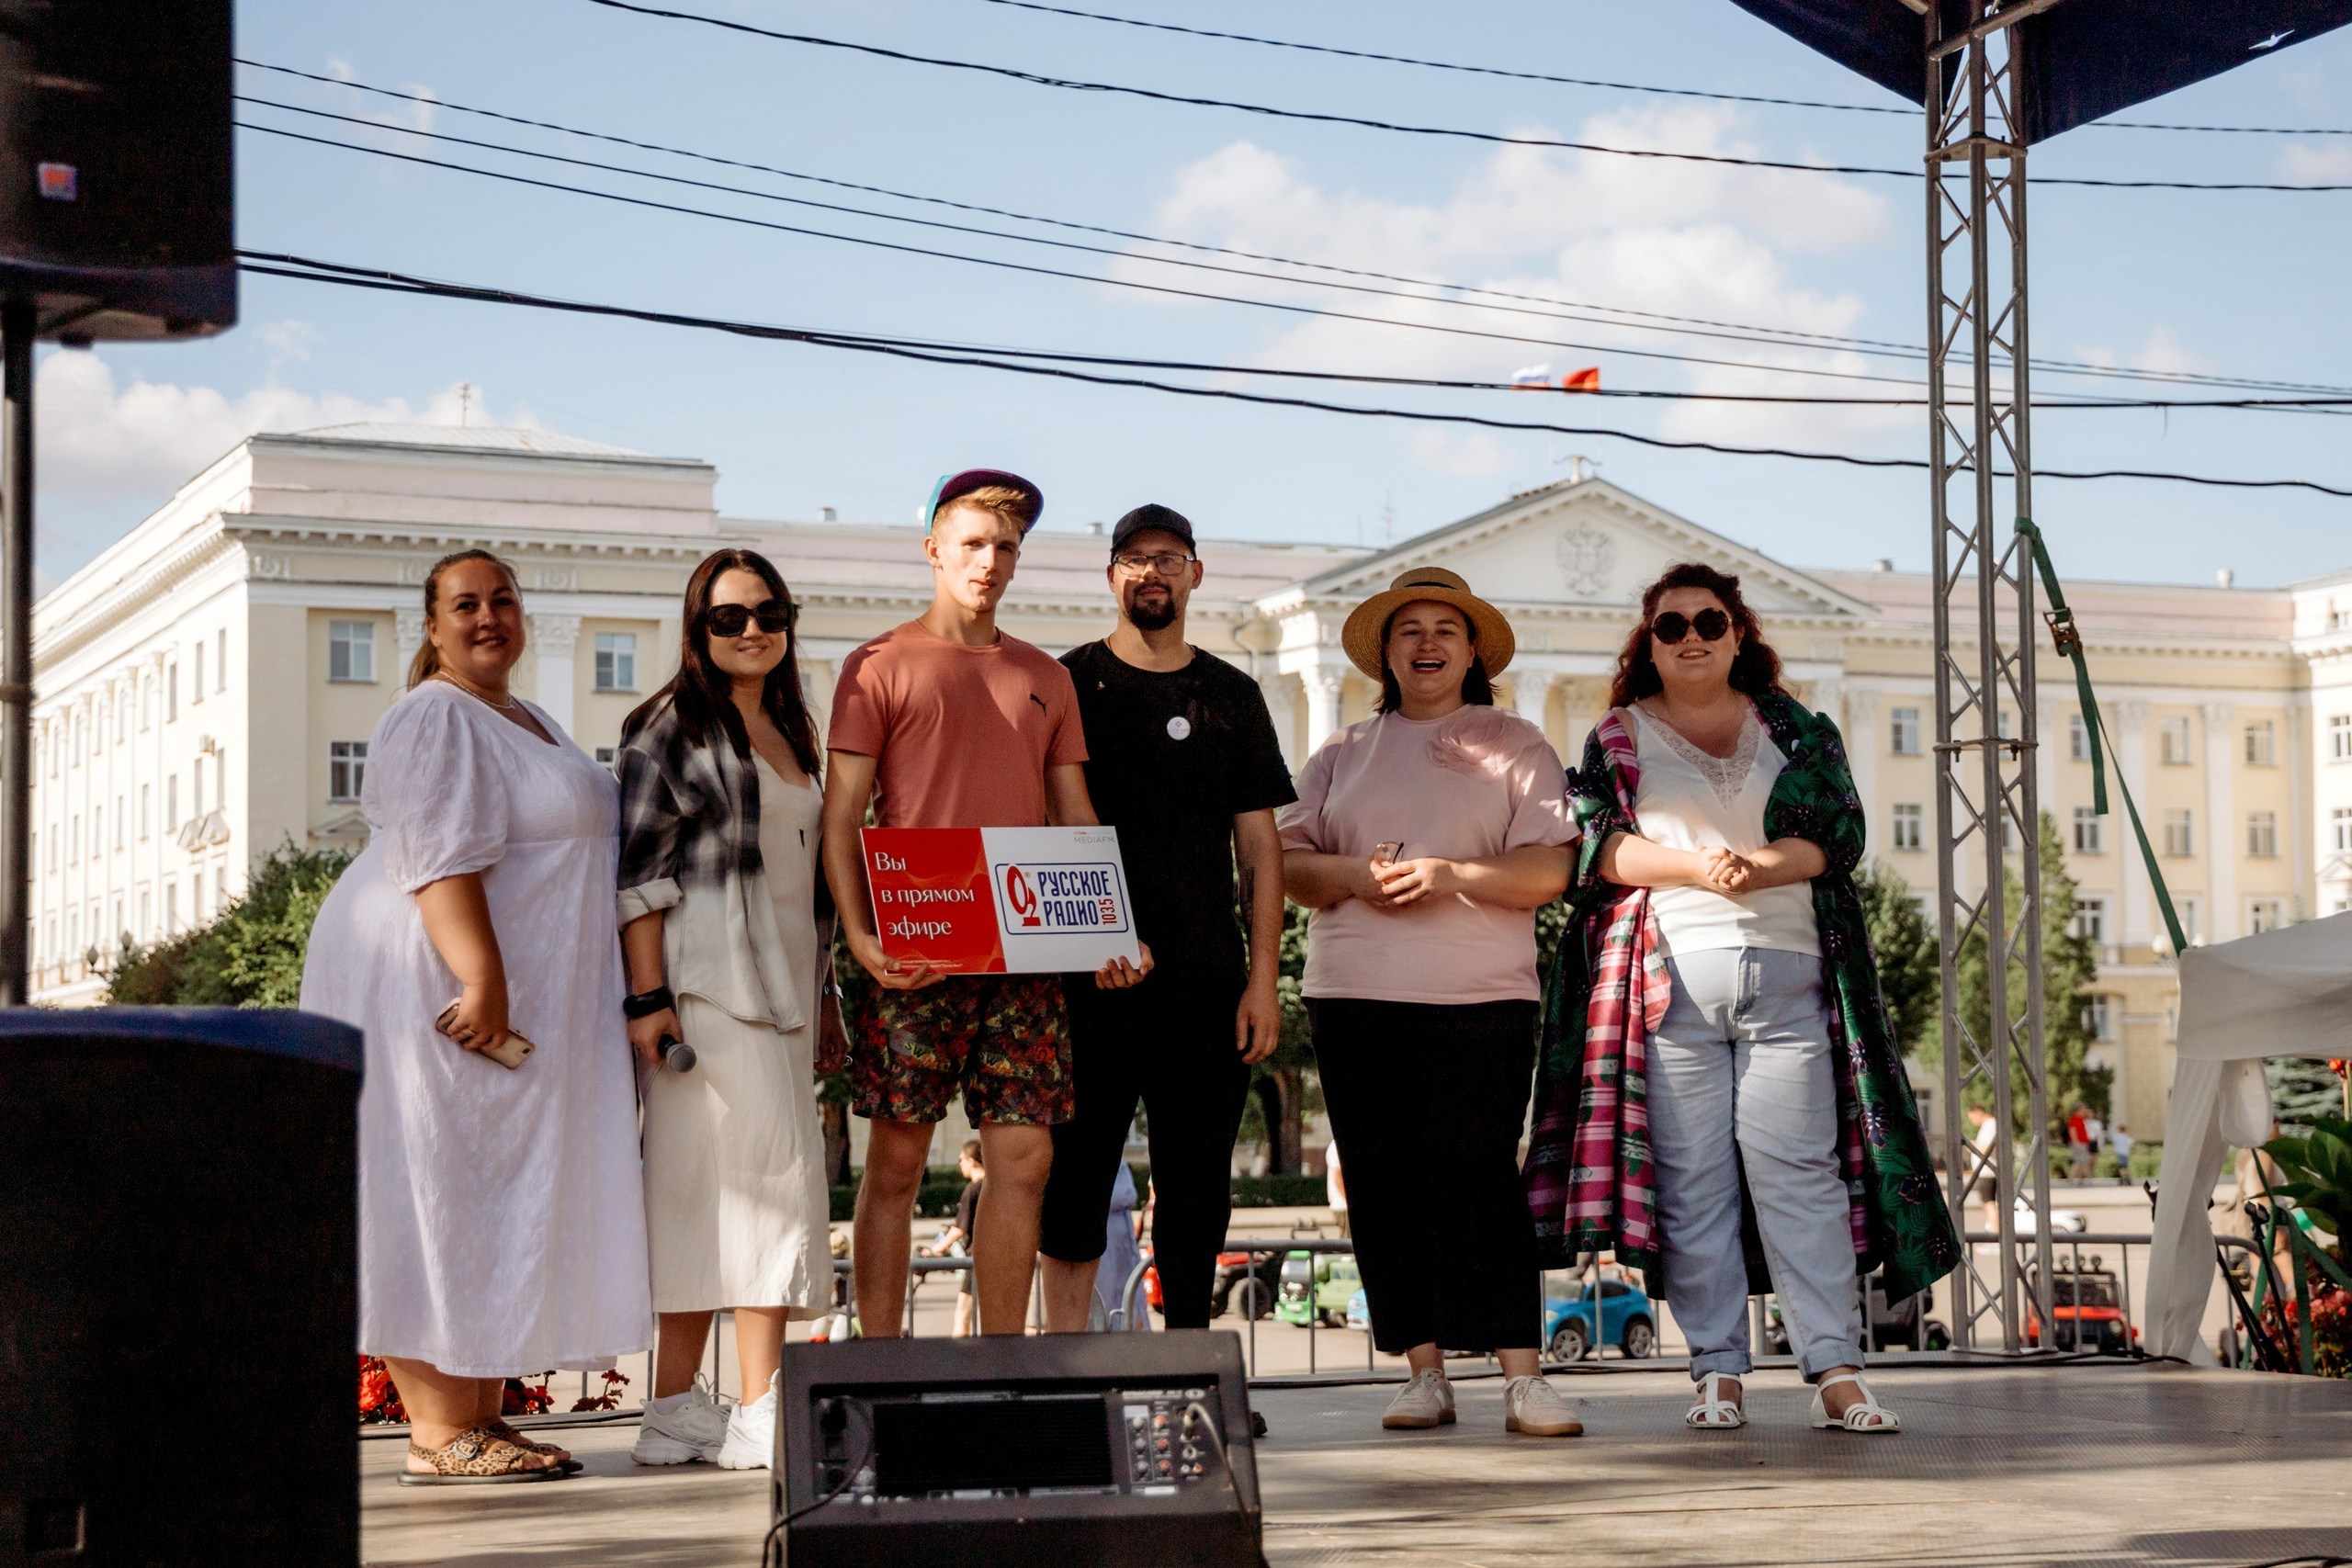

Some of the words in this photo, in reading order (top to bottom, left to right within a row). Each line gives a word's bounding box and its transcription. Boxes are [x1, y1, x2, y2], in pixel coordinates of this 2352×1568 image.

[875, 852, 907, 871] Вы
[1037, 871, 1112, 897] РУССКОЕ
[881, 889, 893, 903] в
[897, 889, 975, 908] прямом
[1043, 900, 1099, 926] РАДИО
[1099, 898, 1117, 925] 103.5
[887, 915, 953, 940] эфире
